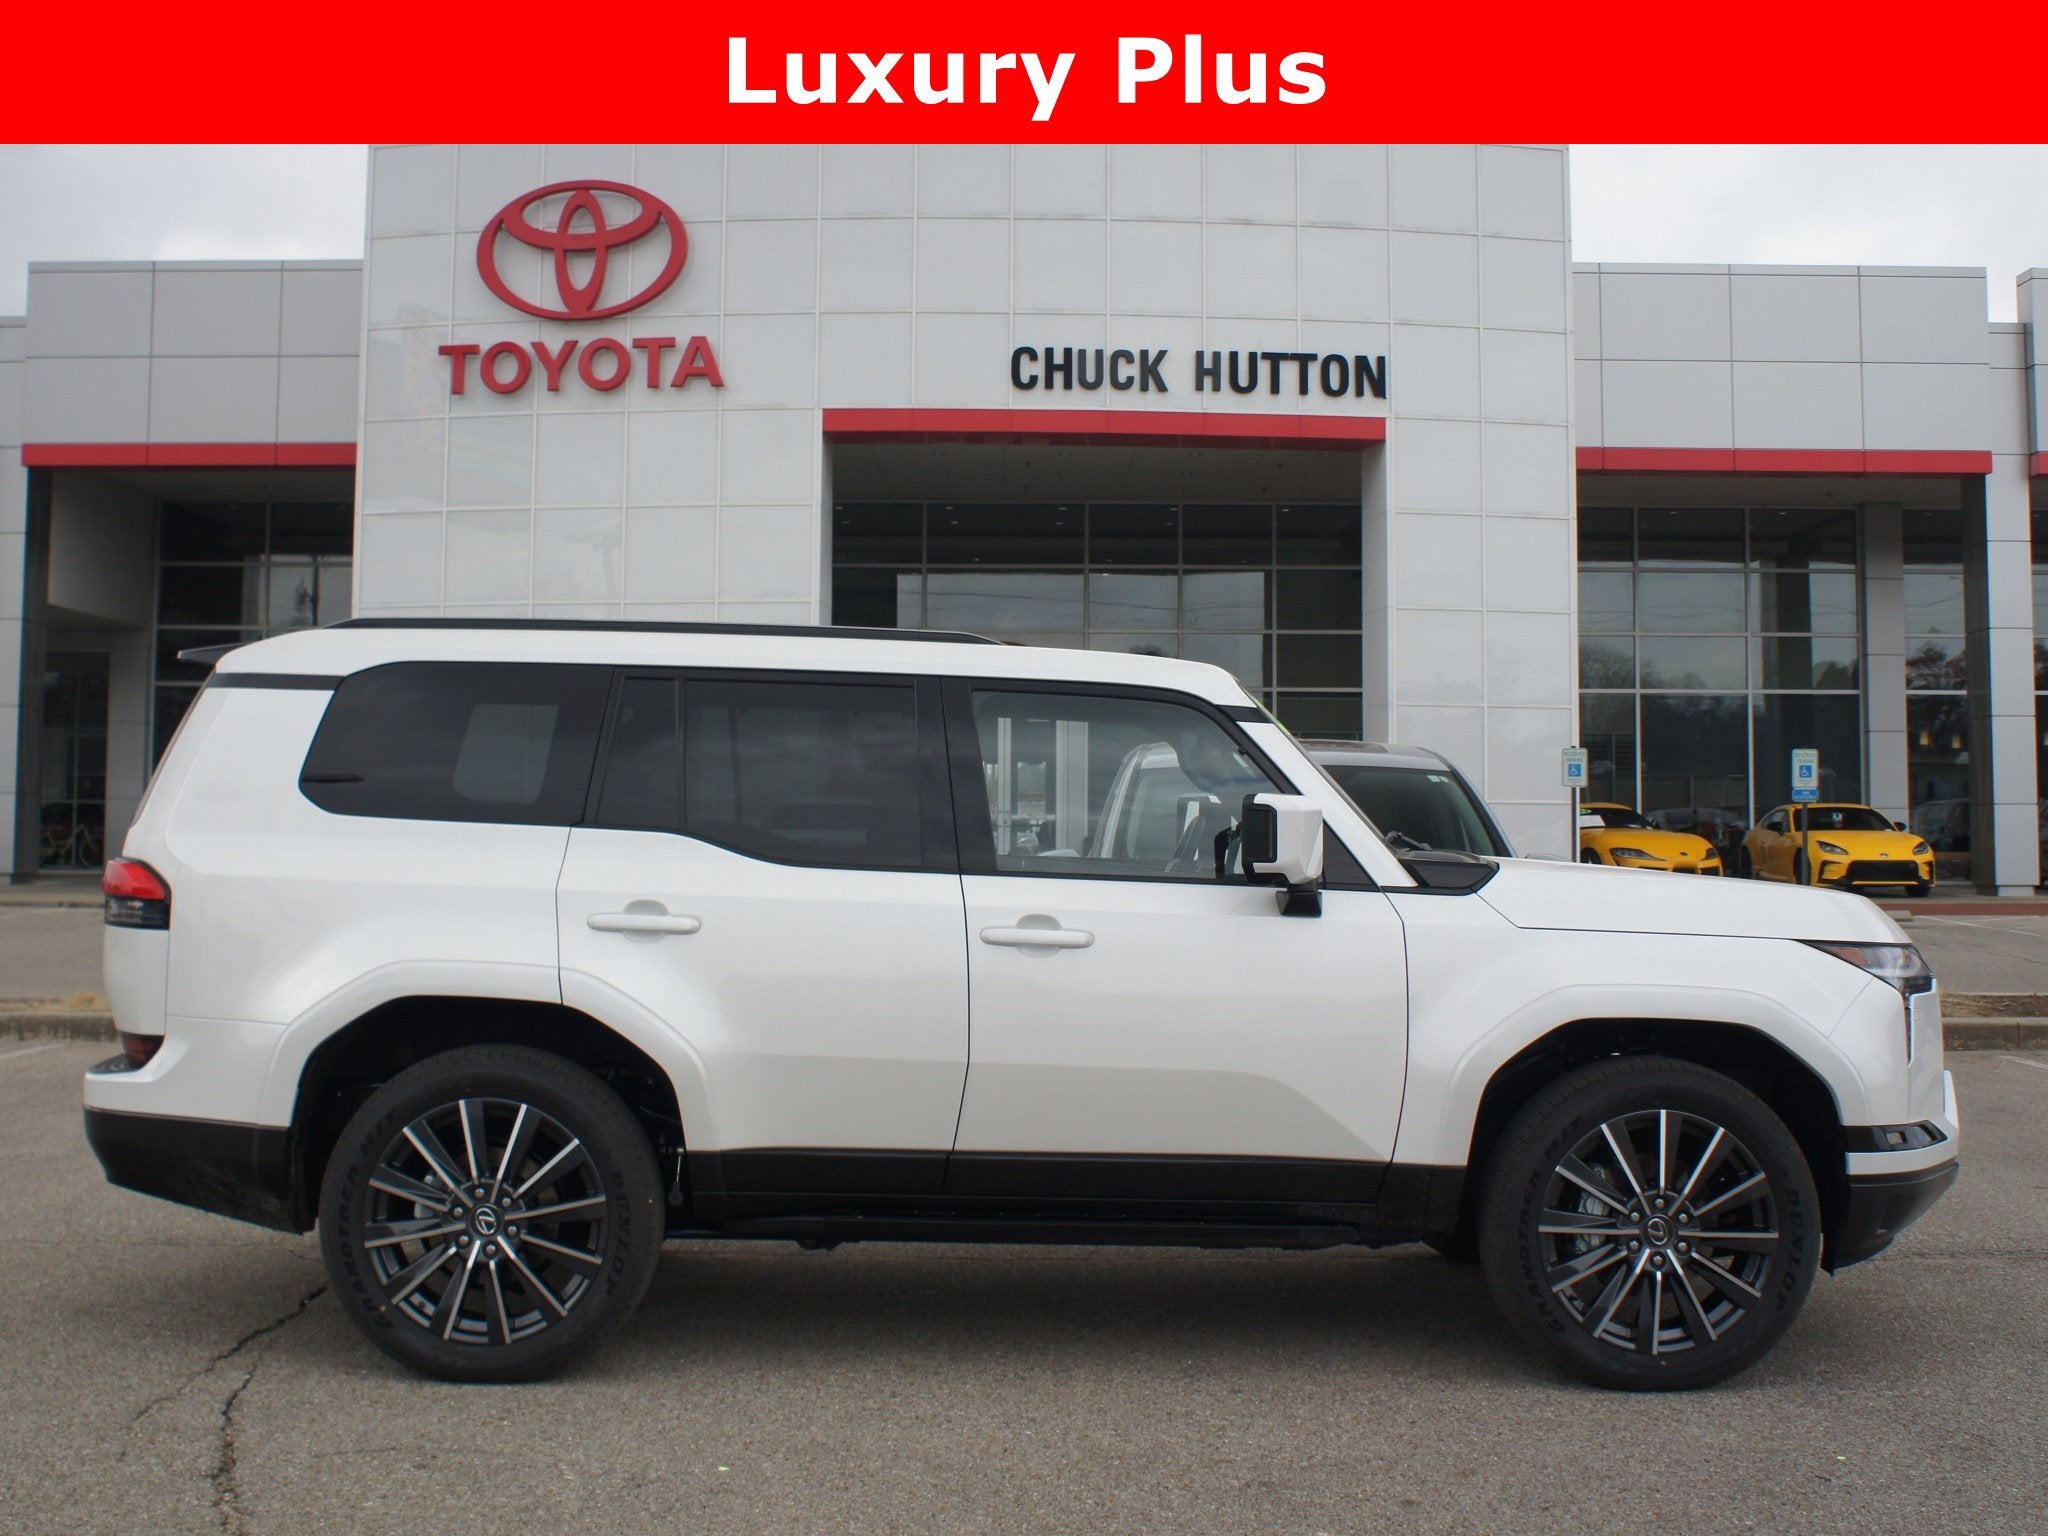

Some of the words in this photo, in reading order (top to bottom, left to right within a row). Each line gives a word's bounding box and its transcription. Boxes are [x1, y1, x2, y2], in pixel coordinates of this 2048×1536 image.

[439, 335, 724, 396] TOYOTA
[1010, 346, 1169, 393] CHUCK
[1195, 350, 1387, 400] HUTTON
[606, 1172, 631, 1297] DUNLOP
[1775, 1189, 1803, 1311] DUNLOP
